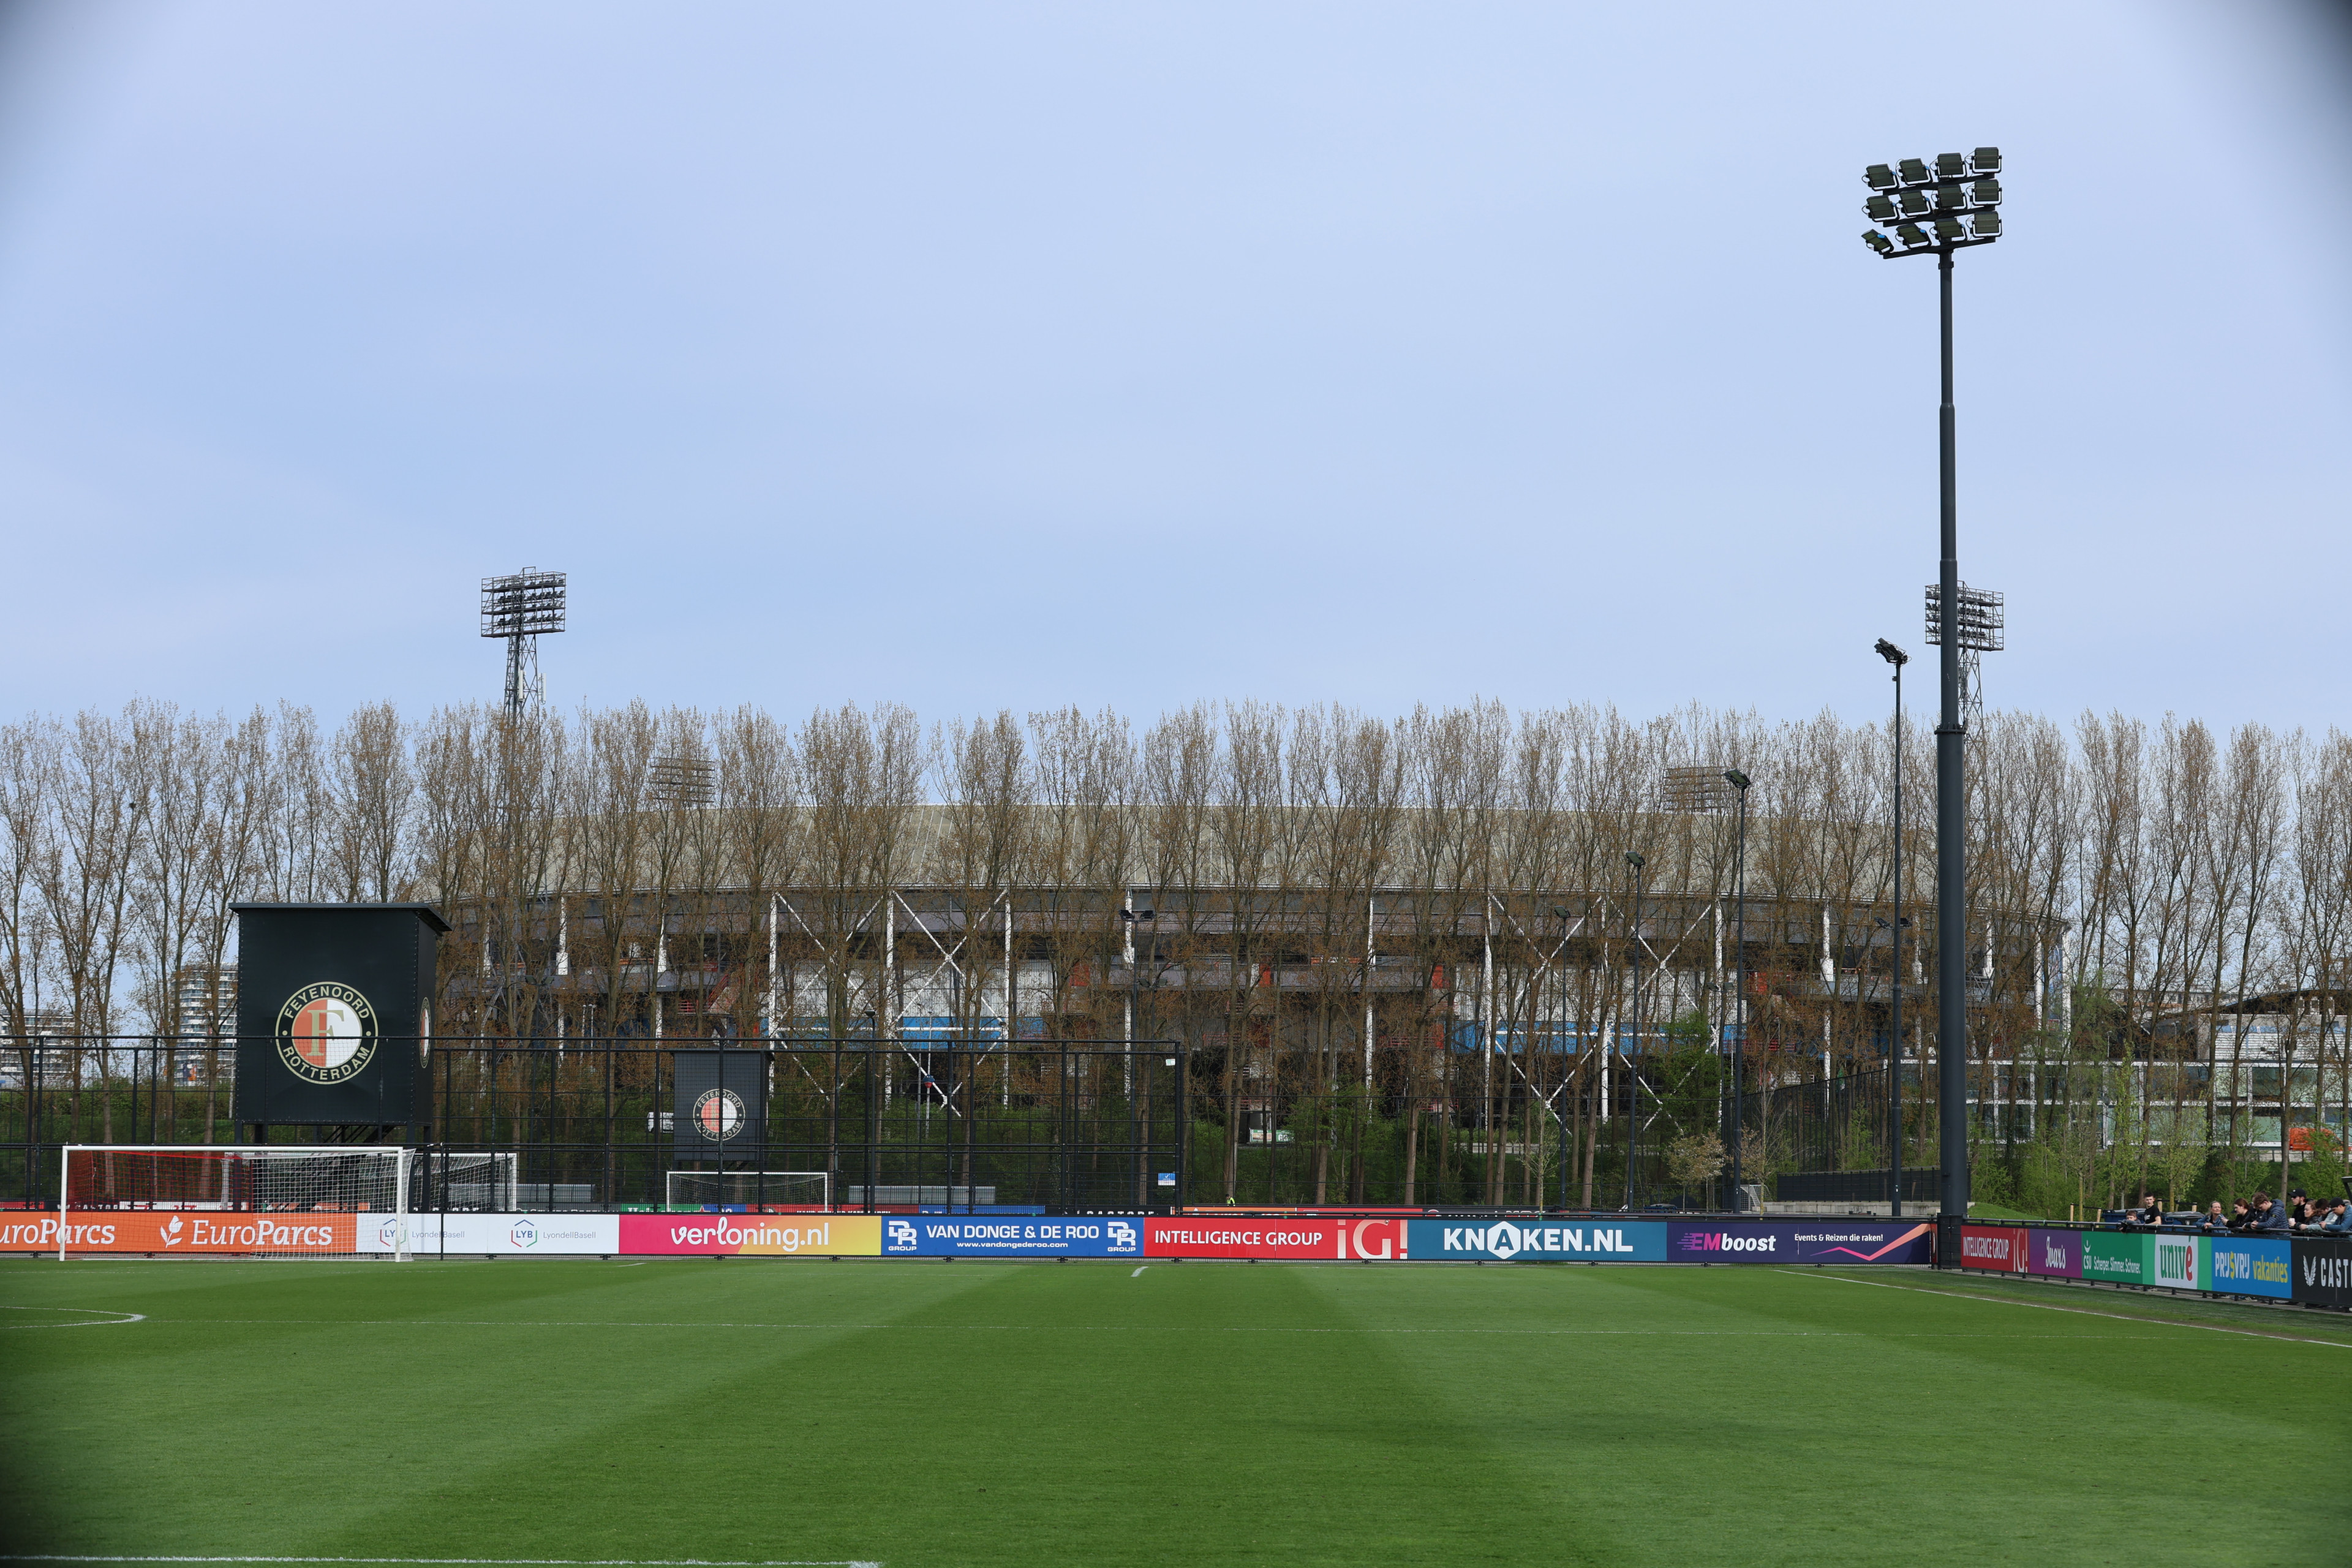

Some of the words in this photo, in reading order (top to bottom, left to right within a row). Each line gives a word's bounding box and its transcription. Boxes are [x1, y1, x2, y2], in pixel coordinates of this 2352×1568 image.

[284, 986, 370, 1019] FEYENOORD
[283, 1046, 371, 1080] ROTTERDAM
[190, 1219, 333, 1246] EuroParcs
[671, 1216, 829, 1252] verloning.nl
[926, 1225, 960, 1238] VAN
[964, 1225, 1020, 1238] DONGE
[1024, 1226, 1036, 1238] &
[1041, 1226, 1061, 1238] DE
[1066, 1226, 1099, 1238] ROO
[1155, 1230, 1261, 1245] INTELLIGENCE
[1265, 1232, 1322, 1246] GROUP
[1444, 1228, 1634, 1252] KNAKEN.NL
[1678, 1233, 1777, 1251] EMboost
[1963, 1237, 1992, 1258] INTELLIGENCE
[1992, 1238, 2009, 1260] GROUP
[2083, 1255, 2092, 1270] CSU
[2094, 1256, 2109, 1274] Scherper.
[2252, 1254, 2288, 1283] vakanties
